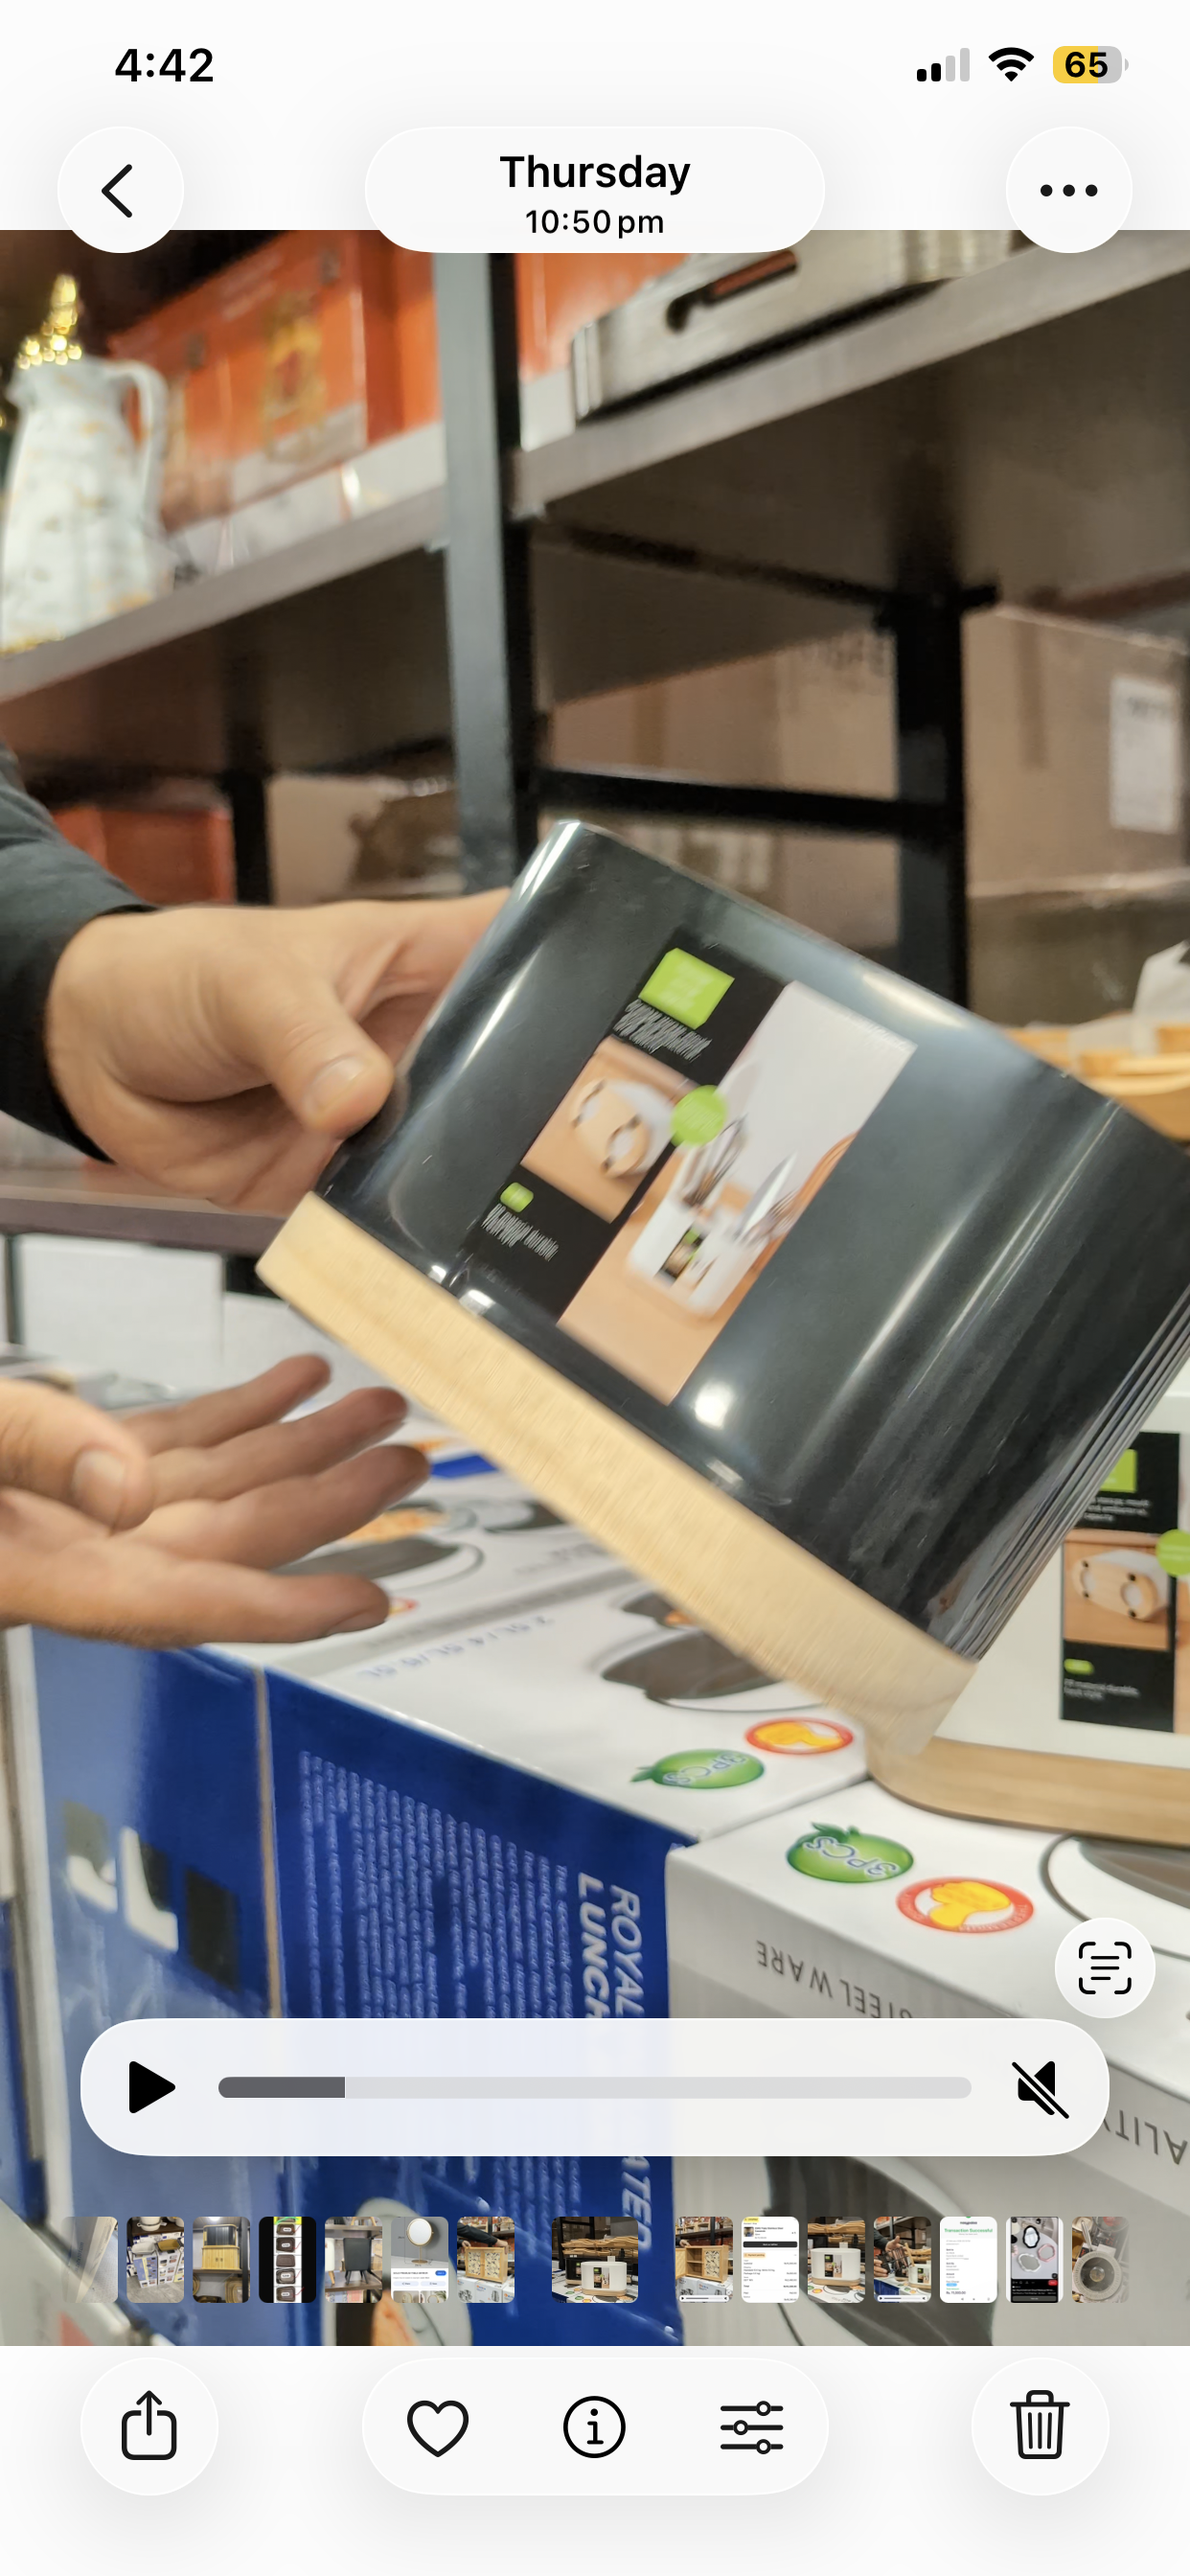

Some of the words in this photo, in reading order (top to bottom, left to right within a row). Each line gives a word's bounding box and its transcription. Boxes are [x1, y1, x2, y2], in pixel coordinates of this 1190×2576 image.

[662, 1751, 747, 1786] 3PCS
[805, 1835, 902, 1877] 3PCS
[609, 1884, 645, 2018] ROYAL
[756, 1939, 834, 1999] WARE
